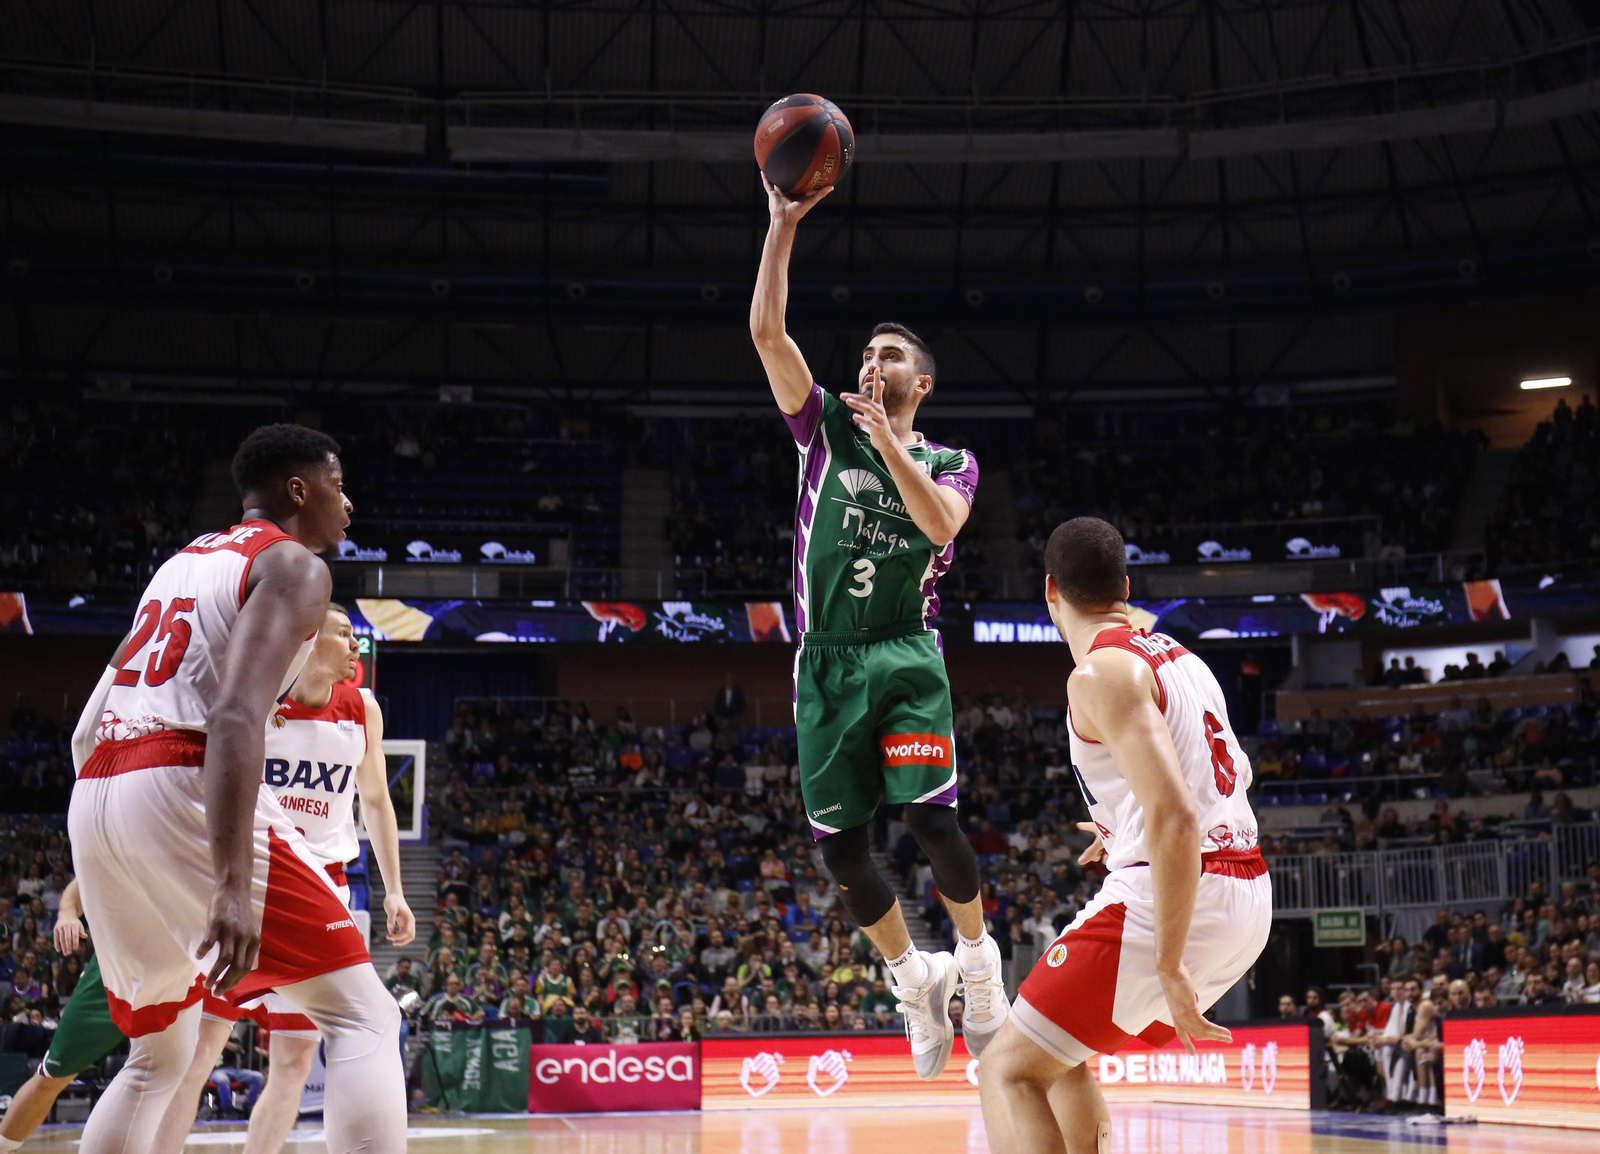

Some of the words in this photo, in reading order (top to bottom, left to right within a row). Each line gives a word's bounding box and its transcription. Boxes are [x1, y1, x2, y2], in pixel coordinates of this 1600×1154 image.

[878, 494, 909, 514] Uni
[837, 539, 862, 549] Ciudad
[842, 506, 909, 554] Málaga
[847, 558, 877, 599] 3
[113, 597, 196, 688] 25
[885, 741, 944, 760] worten
[1202, 710, 1237, 798] 6
[265, 759, 352, 793] BAXI
[276, 795, 329, 819] ANRESA
[813, 802, 842, 819] SPALDING
[535, 1050, 693, 1085] endesa
